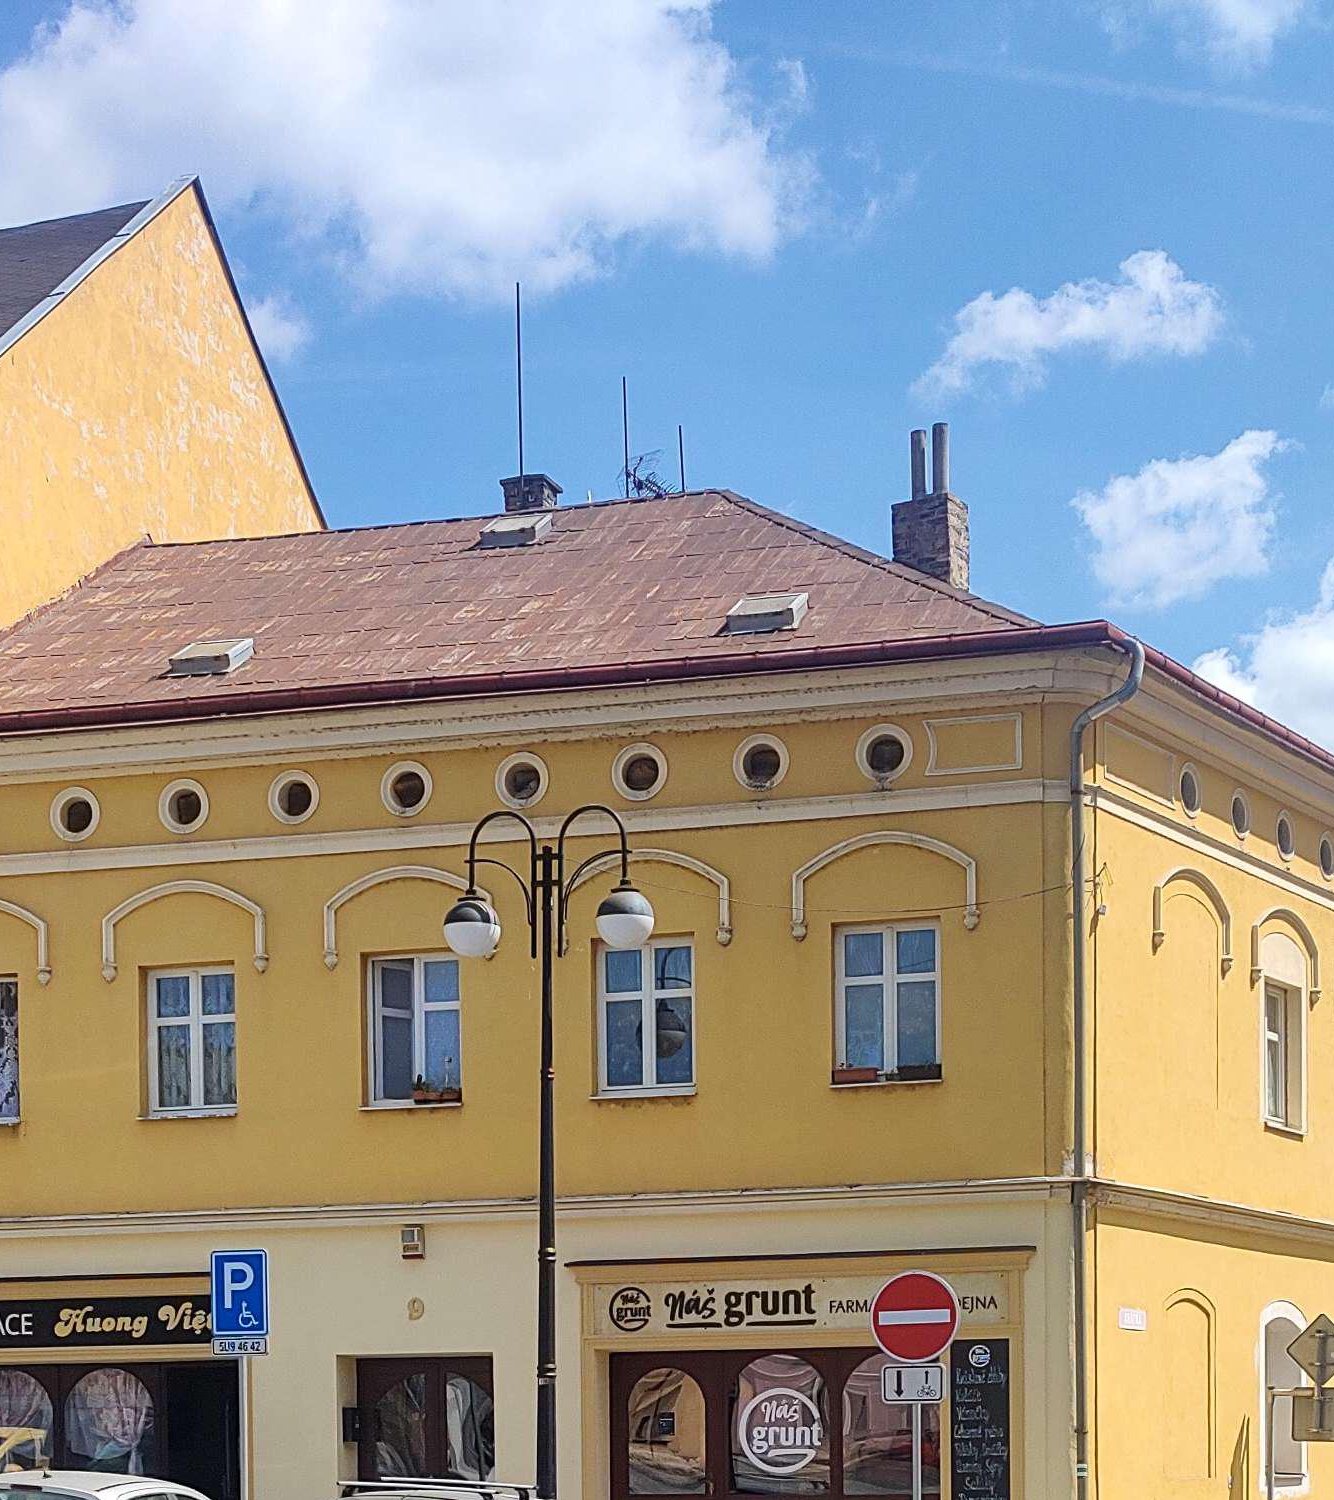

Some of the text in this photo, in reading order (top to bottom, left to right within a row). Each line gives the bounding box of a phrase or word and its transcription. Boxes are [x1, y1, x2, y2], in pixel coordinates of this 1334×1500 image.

[223, 1262, 254, 1309] P
[407, 1297, 425, 1321] 9
[616, 1304, 652, 1321] grunt
[664, 1288, 716, 1320] Náš
[723, 1283, 816, 1327] grunt
[957, 1295, 998, 1313] EJNA
[54, 1305, 149, 1339] Huong
[250, 1341, 262, 1352] 42
[761, 1399, 800, 1423] Náš
[752, 1421, 821, 1454] grunt
